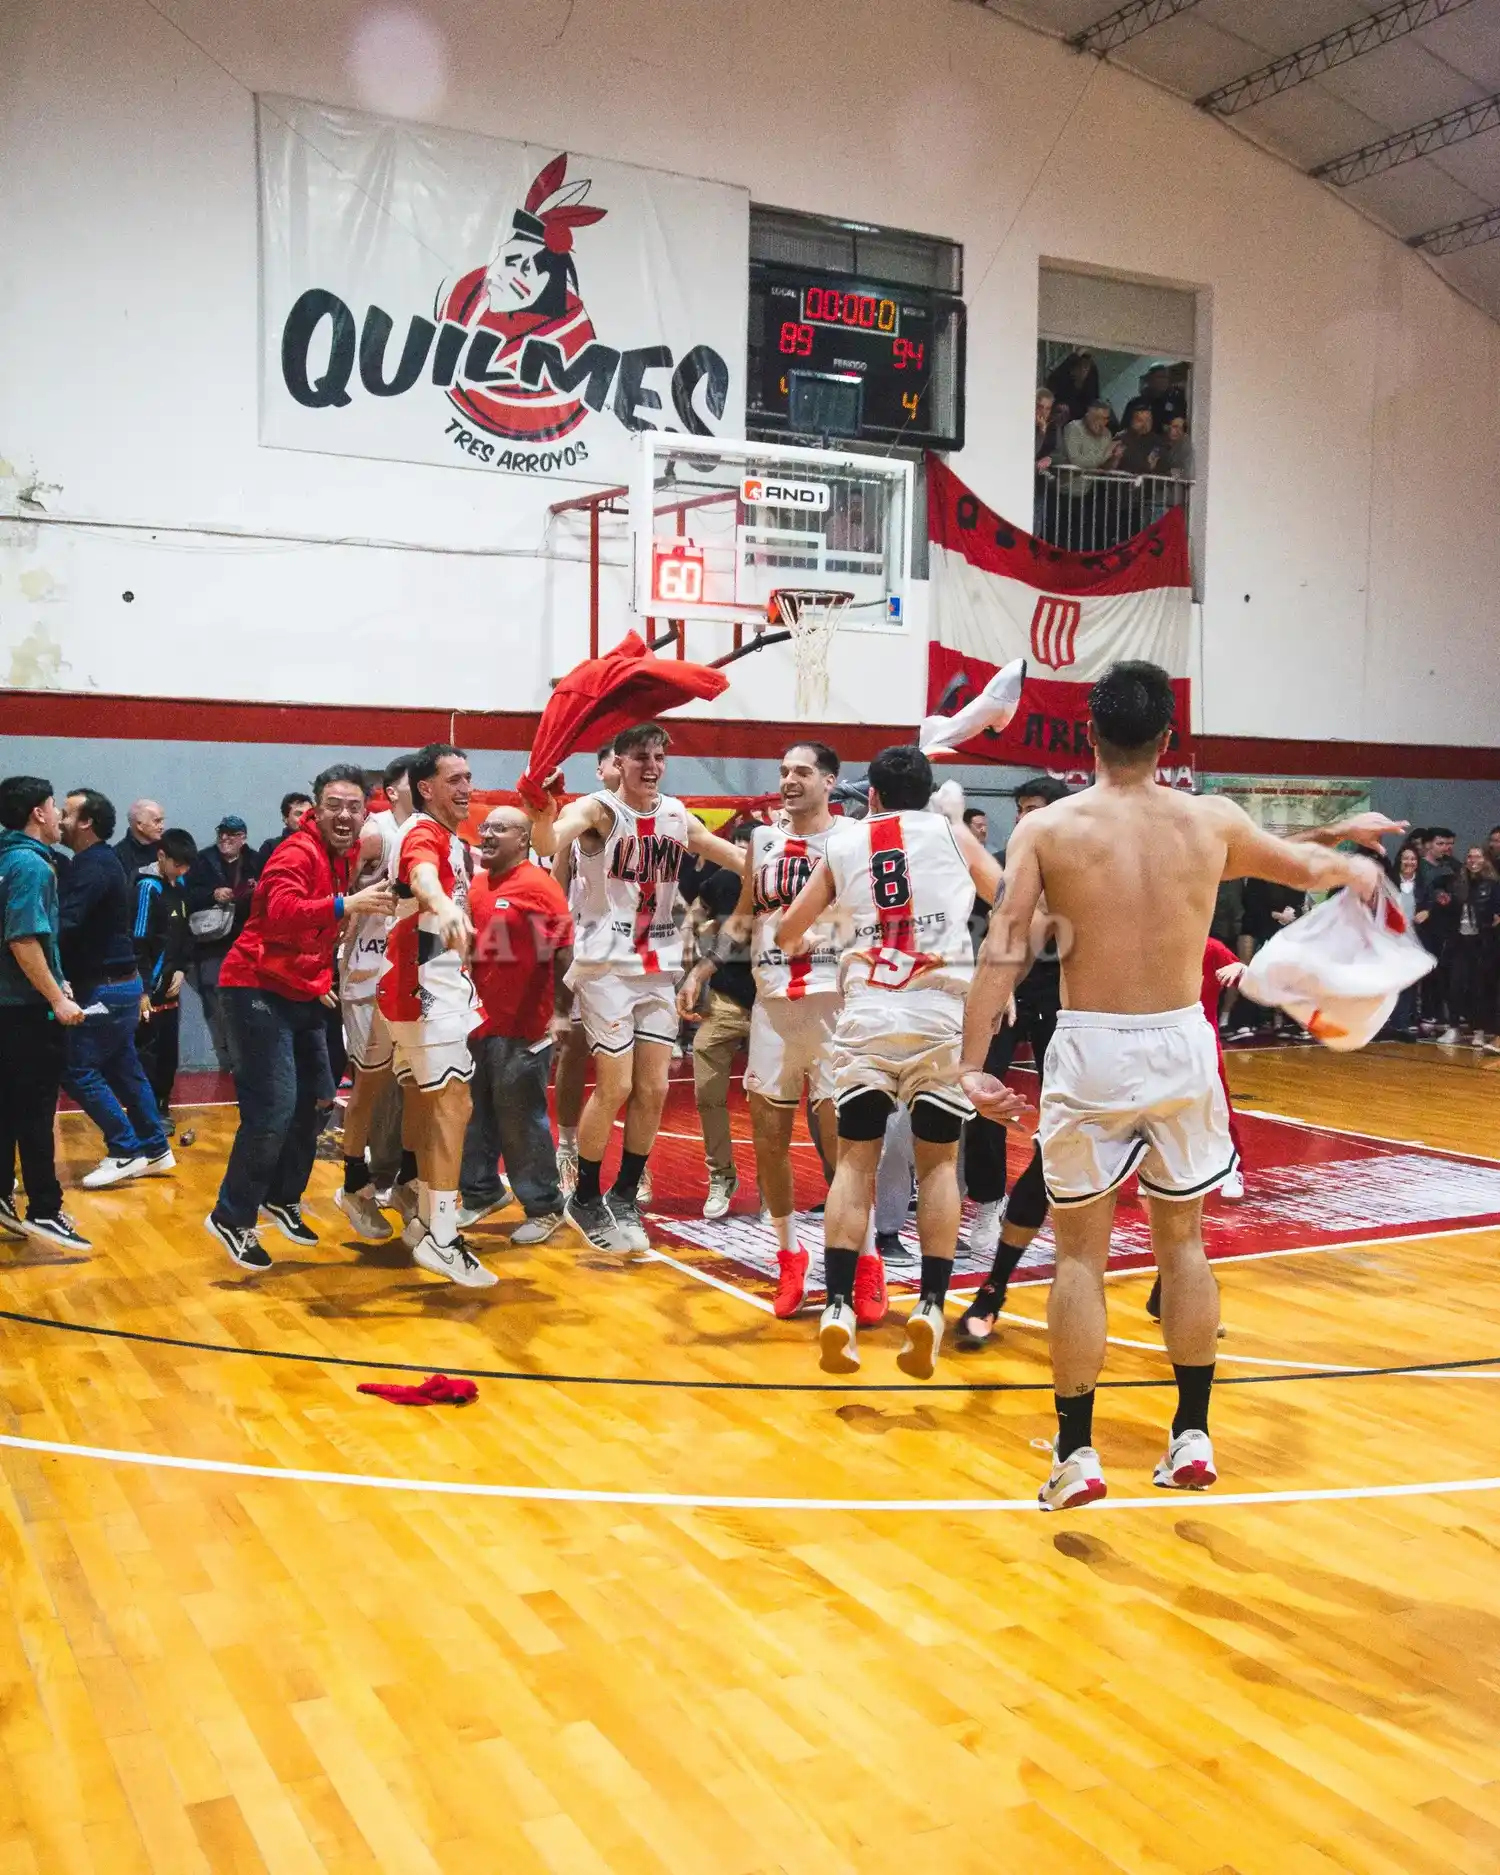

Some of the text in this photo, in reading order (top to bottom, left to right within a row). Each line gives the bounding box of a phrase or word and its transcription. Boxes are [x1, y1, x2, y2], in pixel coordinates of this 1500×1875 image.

[779, 321, 815, 356] 89
[892, 337, 924, 370] 94
[281, 287, 729, 437] QUILMES
[902, 391, 919, 420] 4
[444, 416, 589, 473] TRES ARROYOS
[659, 560, 702, 601] 60
[869, 848, 913, 910] 8
